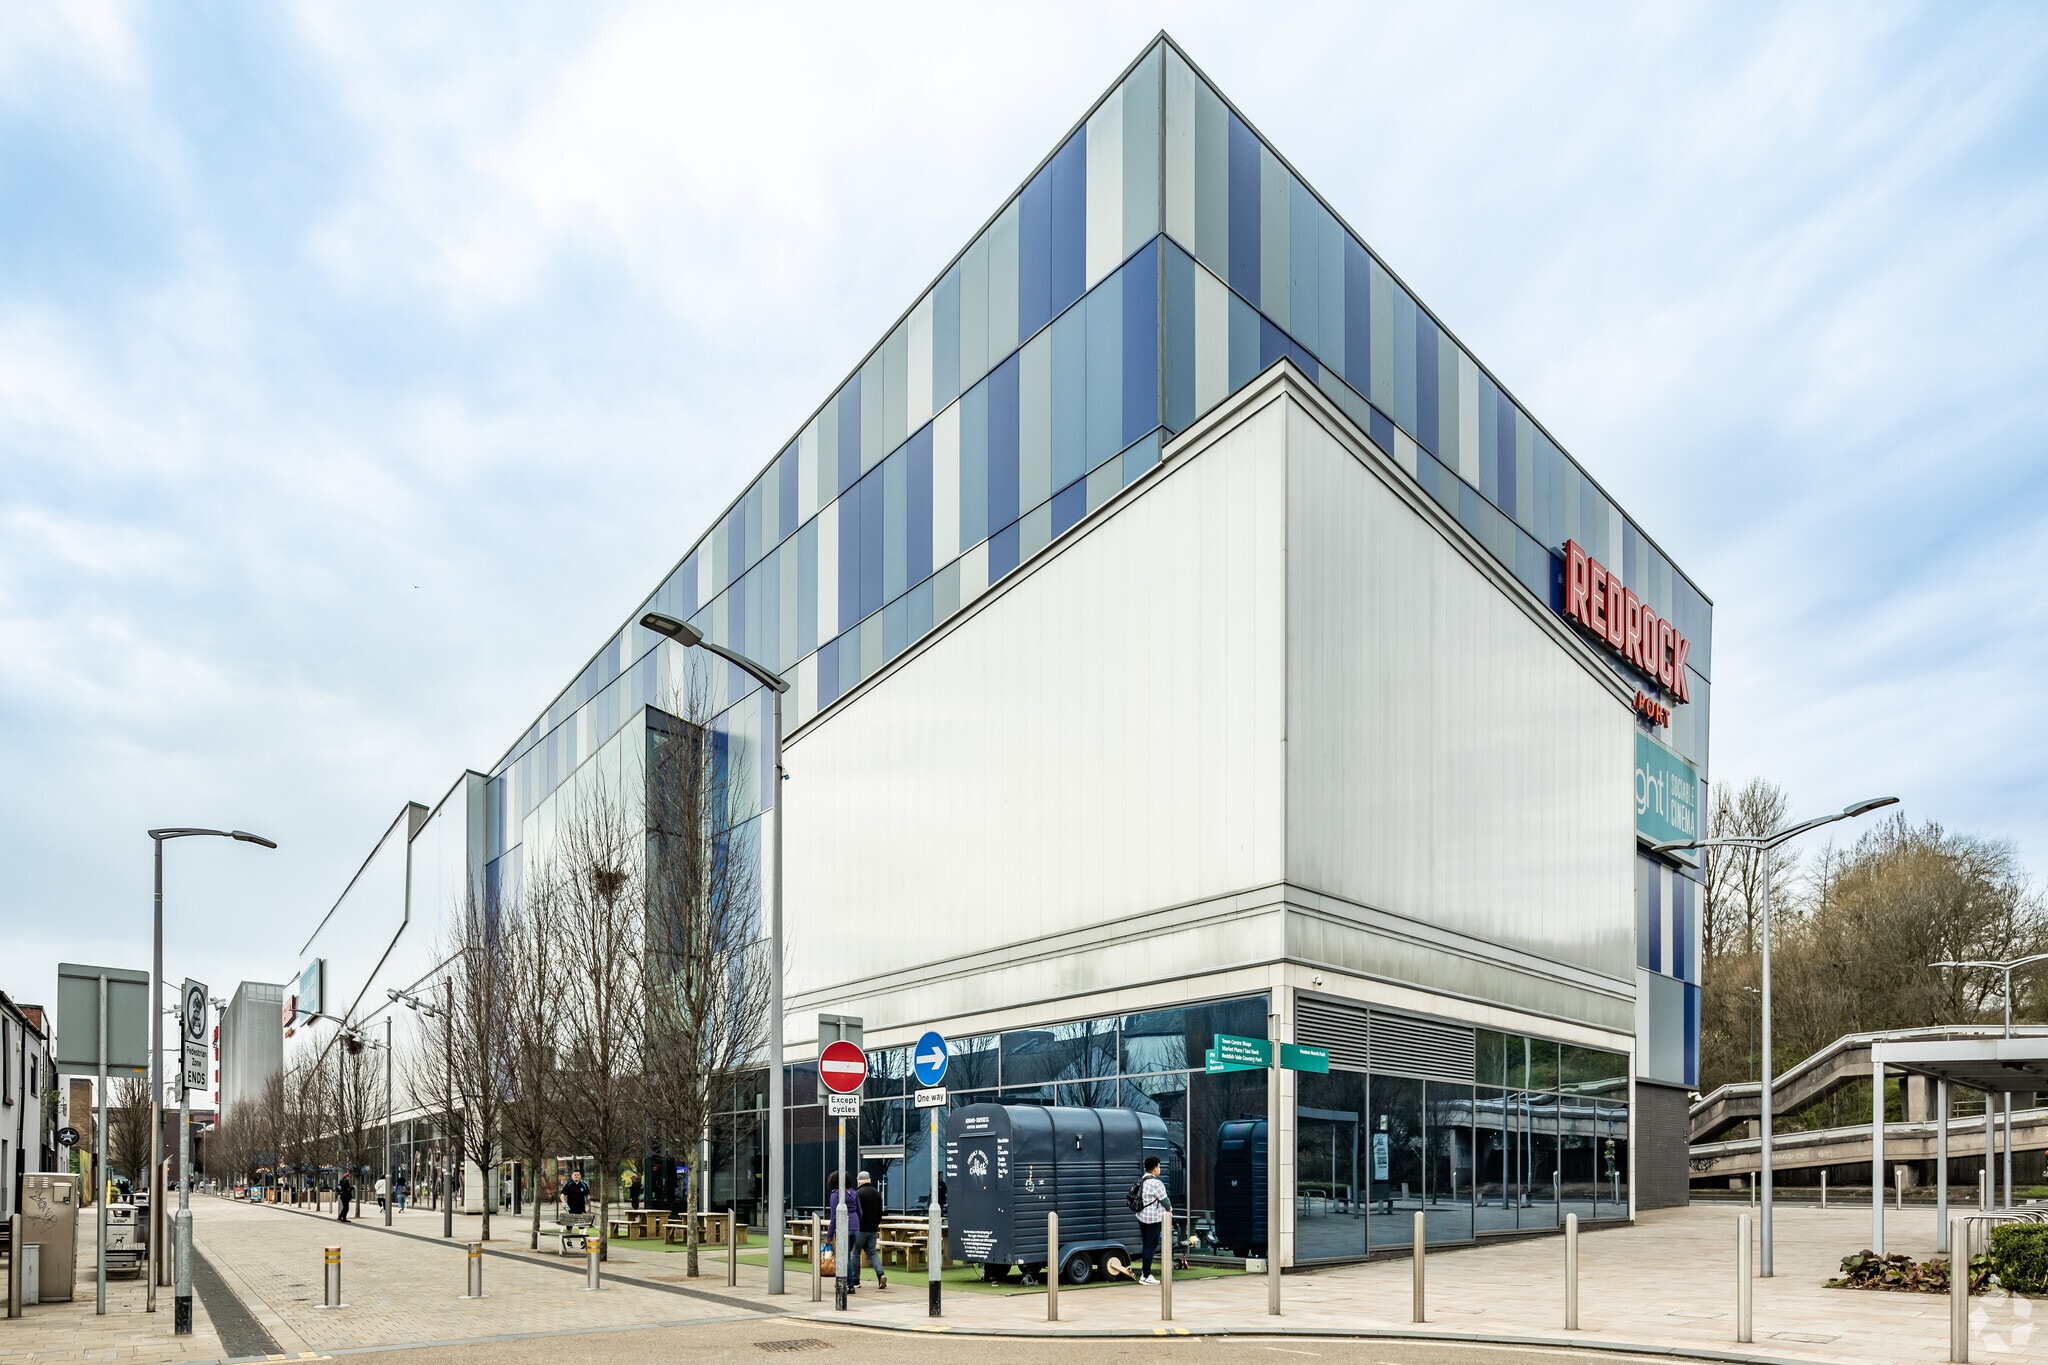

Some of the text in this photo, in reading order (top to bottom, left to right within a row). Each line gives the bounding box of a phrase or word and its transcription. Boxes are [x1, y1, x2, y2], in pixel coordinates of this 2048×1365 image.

[1566, 539, 1691, 704] REDROCK
[1632, 690, 1670, 729] PORT
[1670, 773, 1694, 808] SOCIABLE
[1671, 798, 1695, 837] CINEMA
[186, 1045, 207, 1058] Pedestrian
[191, 1057, 202, 1067] Zone
[187, 1070, 206, 1085] ENDS
[831, 1096, 857, 1104] Except
[916, 1093, 944, 1103] One way
[832, 1105, 856, 1113] cycles
